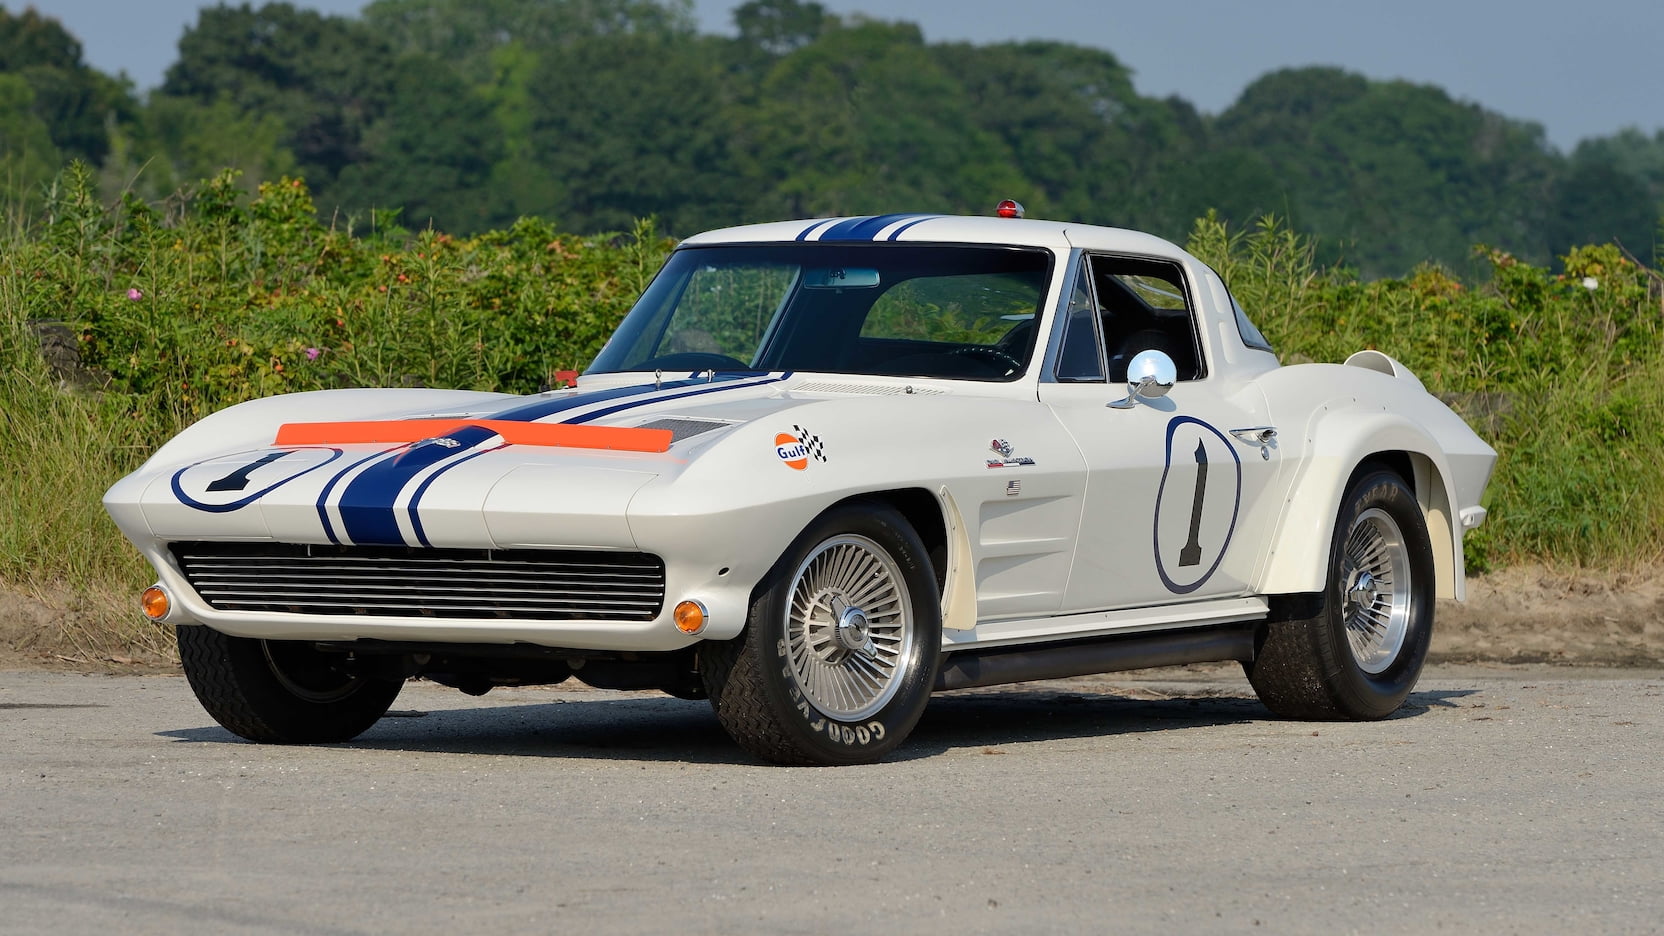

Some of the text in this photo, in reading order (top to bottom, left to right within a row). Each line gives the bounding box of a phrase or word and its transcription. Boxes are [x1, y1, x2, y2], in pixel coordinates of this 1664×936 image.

[205, 451, 295, 492] 1
[777, 445, 805, 459] Gulf
[1178, 436, 1208, 567] 1
